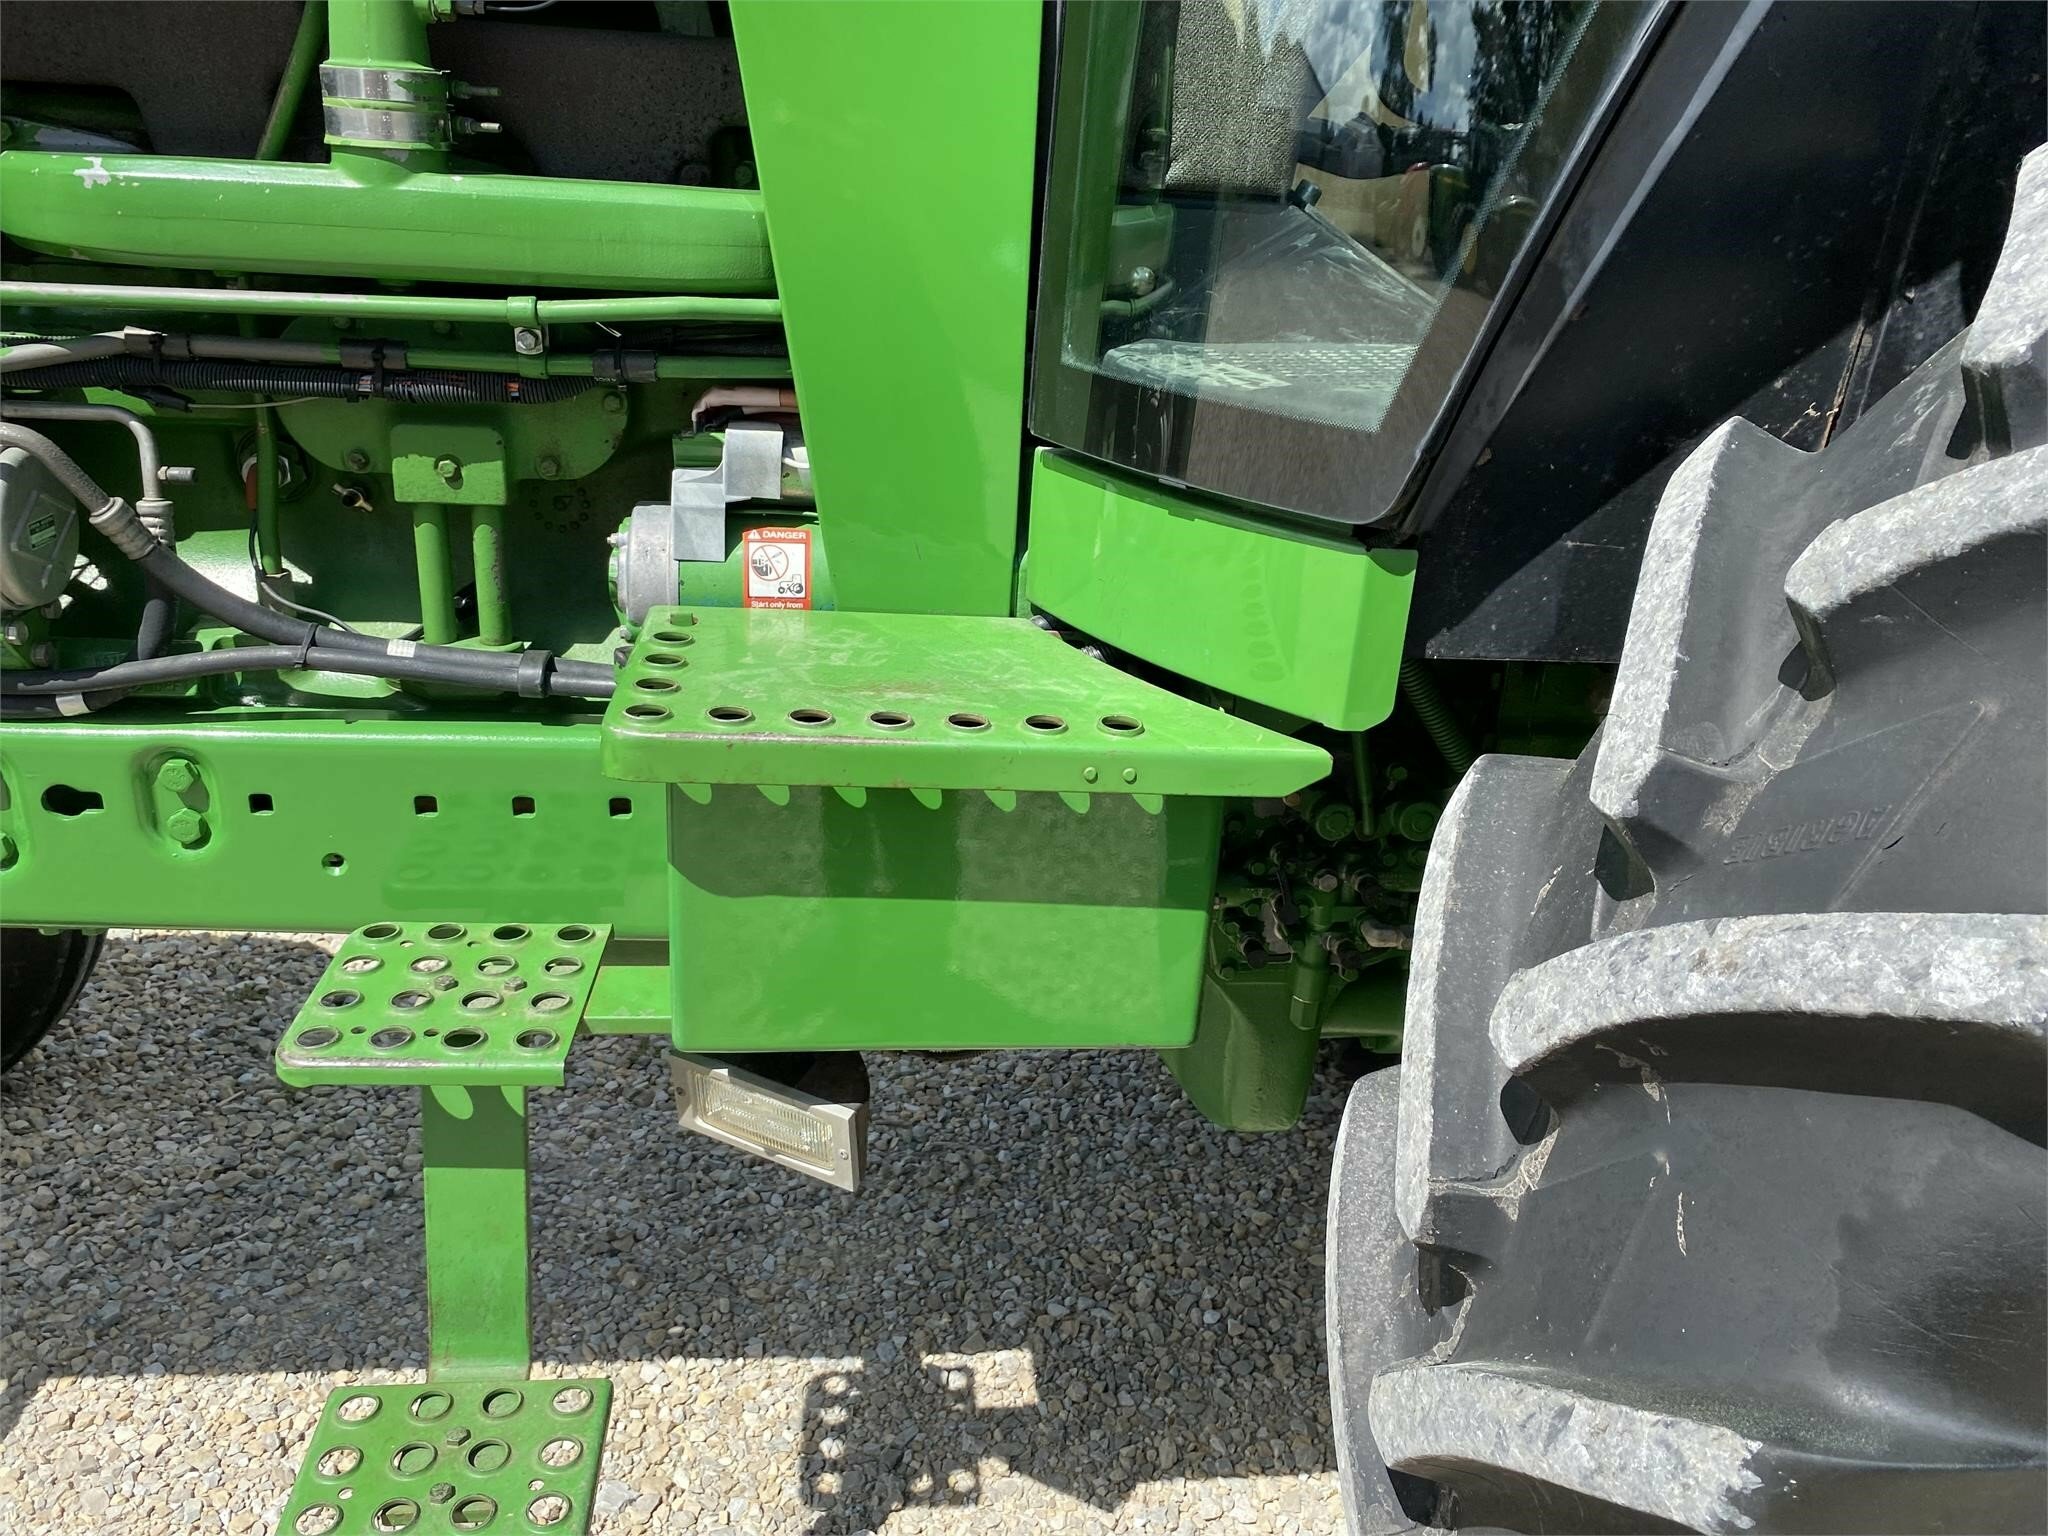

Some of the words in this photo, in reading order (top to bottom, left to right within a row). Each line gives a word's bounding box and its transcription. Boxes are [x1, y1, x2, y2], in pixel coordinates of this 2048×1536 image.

[762, 530, 806, 539] DANGER
[751, 600, 769, 608] Start
[770, 600, 785, 609] only
[786, 600, 804, 608] from
